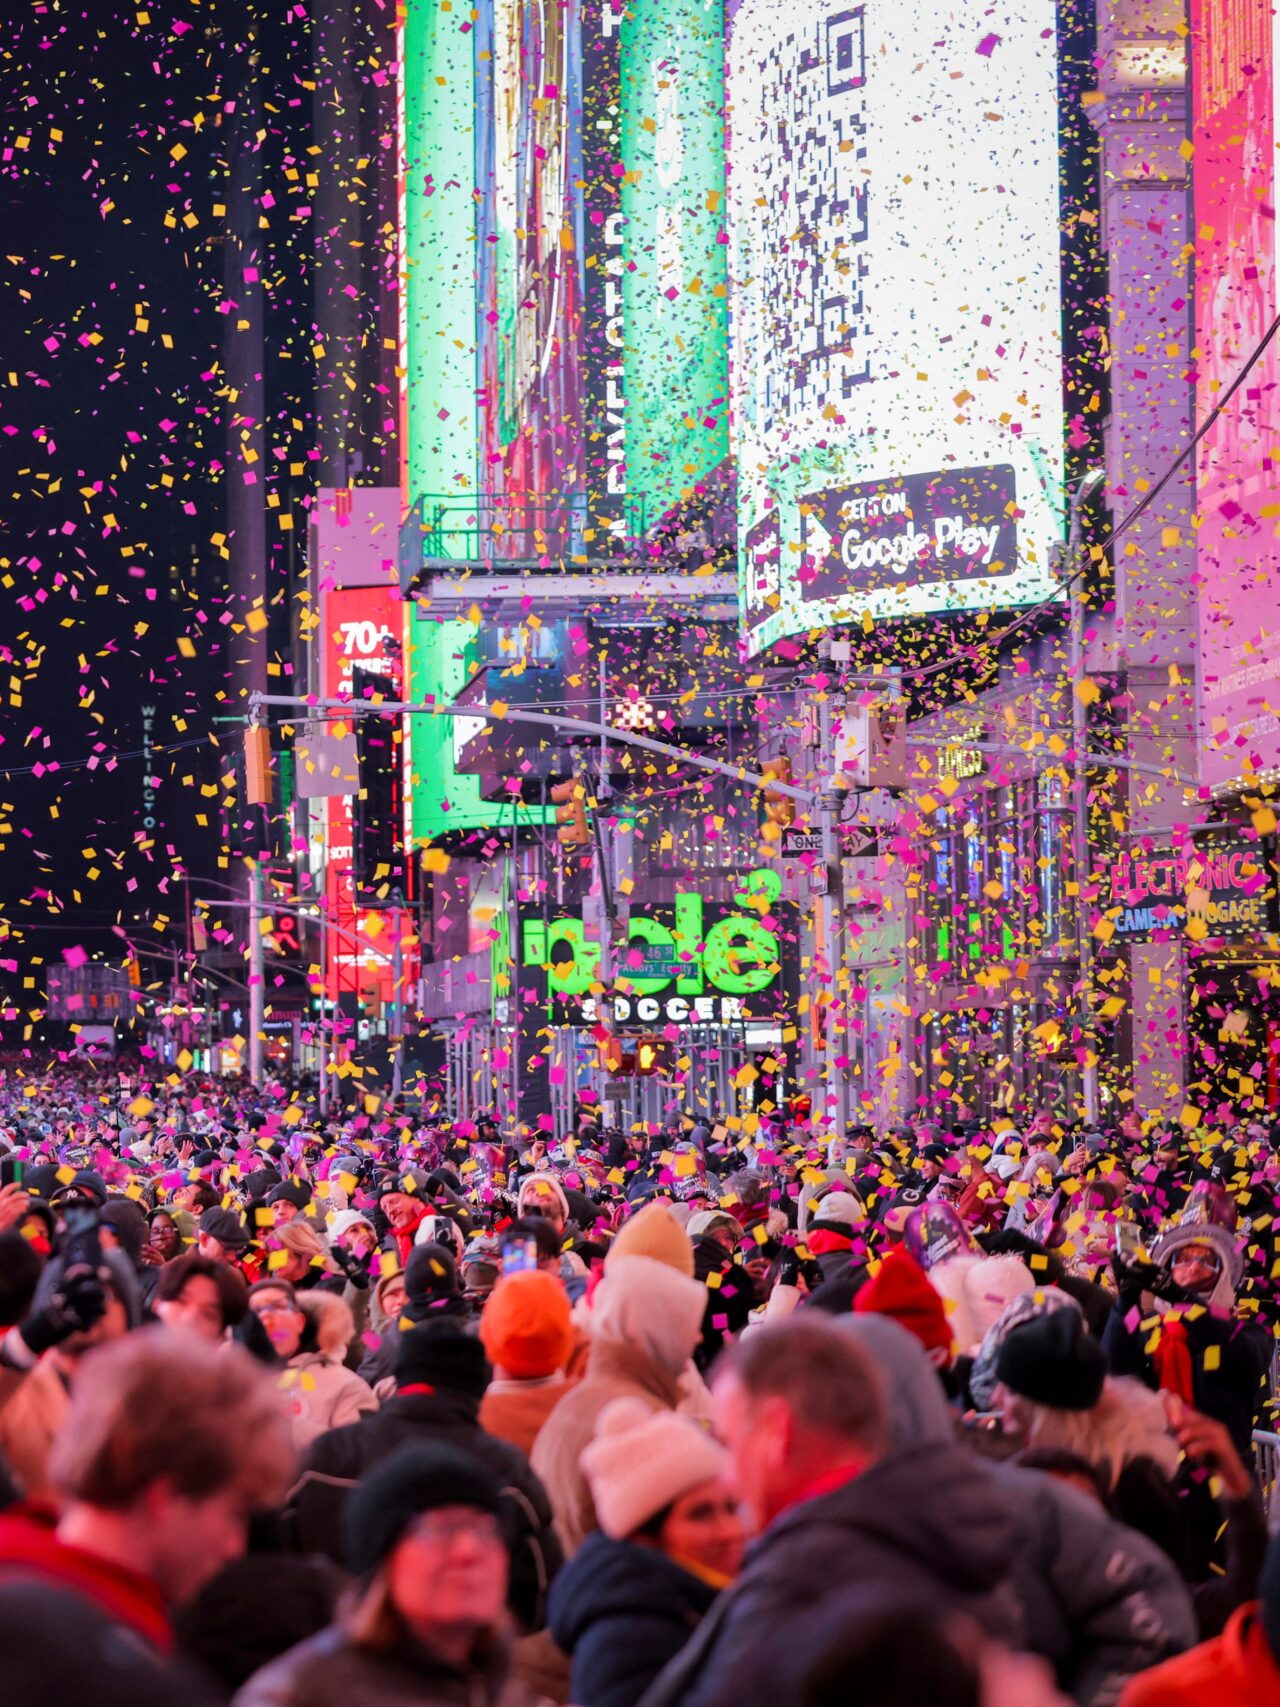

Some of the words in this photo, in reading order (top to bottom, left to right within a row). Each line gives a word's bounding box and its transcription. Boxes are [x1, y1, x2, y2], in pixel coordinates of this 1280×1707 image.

[882, 492, 907, 514] ON
[841, 521, 931, 575] Google
[934, 515, 1001, 565] Play
[1113, 907, 1179, 932] CAMEA
[581, 996, 743, 1022] SOCCER
